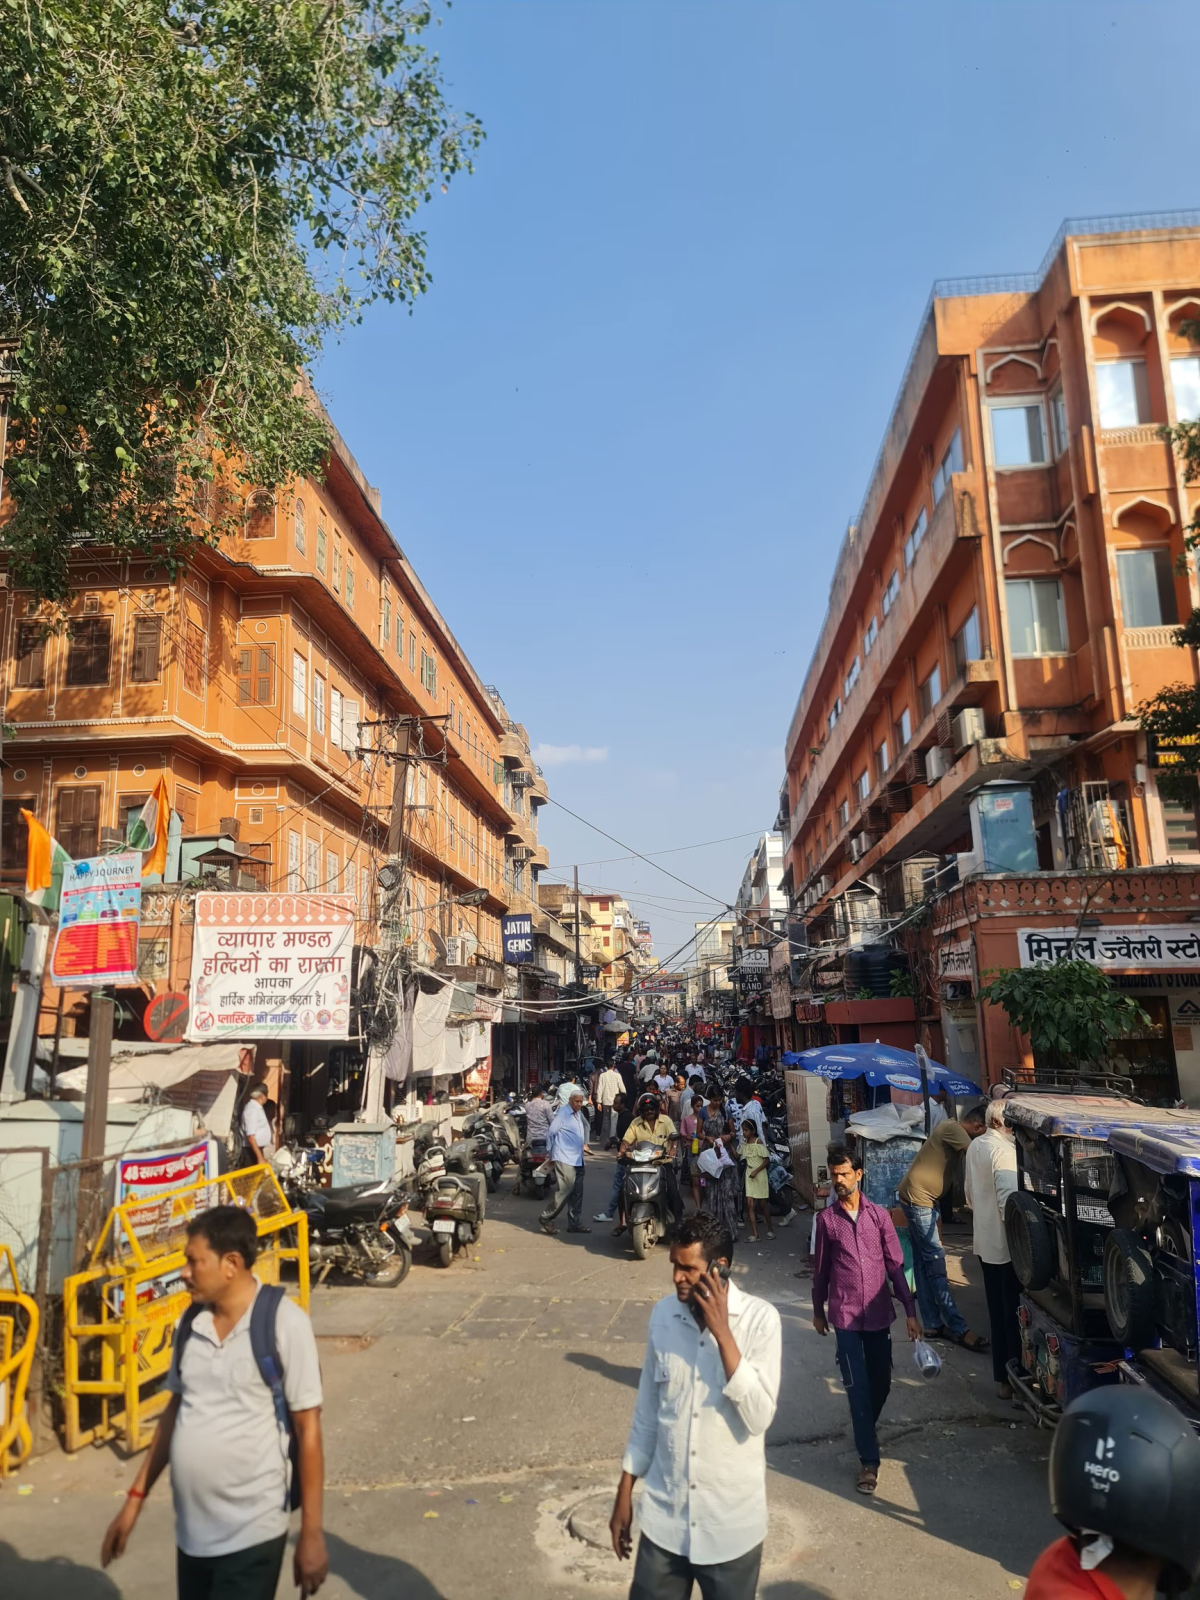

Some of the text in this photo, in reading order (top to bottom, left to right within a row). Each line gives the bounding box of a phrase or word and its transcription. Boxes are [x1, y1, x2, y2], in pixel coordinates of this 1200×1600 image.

[70, 866, 134, 881] HAPPY JOURNEY
[504, 921, 531, 935] JATIN
[217, 931, 333, 948] व्यापार मण्डल
[507, 939, 532, 953] GEMS
[1099, 936, 1162, 959] ज्वैलरी
[745, 951, 766, 960] J.D.
[202, 950, 345, 976] हल्दियों का रास्ता
[740, 967, 762, 975] HINDU
[745, 974, 759, 982] JEA
[254, 978, 293, 989] आपका
[220, 991, 245, 1007] हार्दिक
[217, 1011, 254, 1024] प्लास्टिक
[1084, 1461, 1120, 1482] Hero
